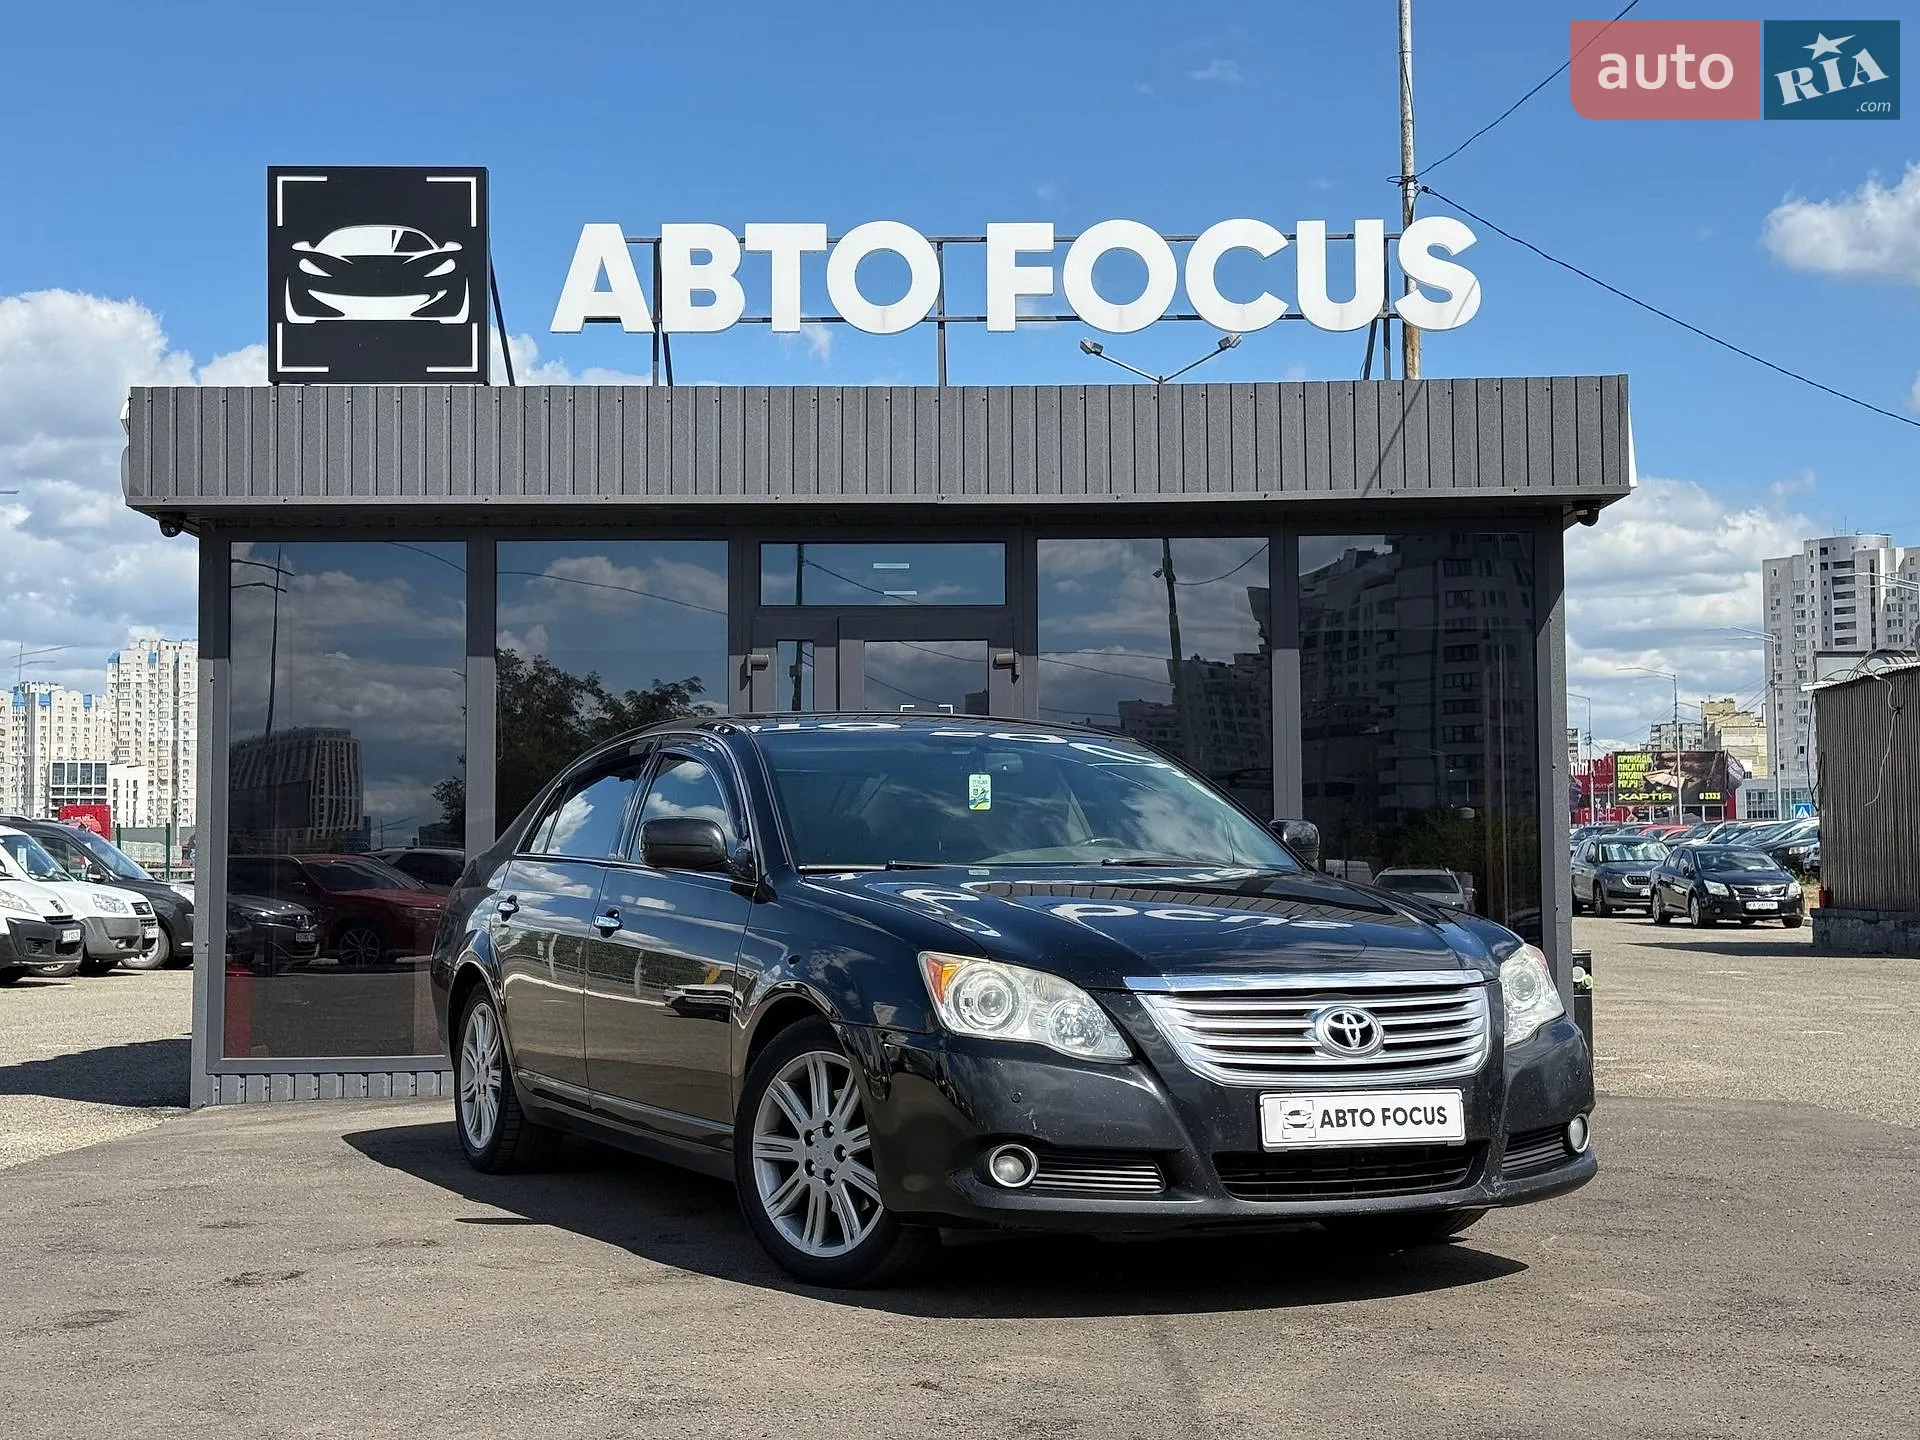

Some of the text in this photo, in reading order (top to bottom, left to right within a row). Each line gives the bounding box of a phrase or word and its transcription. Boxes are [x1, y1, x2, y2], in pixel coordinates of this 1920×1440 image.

[549, 216, 1483, 335] АВТО FOCUS
[1618, 792, 1673, 800] ХАРТІЯ
[1320, 1106, 1447, 1128] АВТО FOCUS
